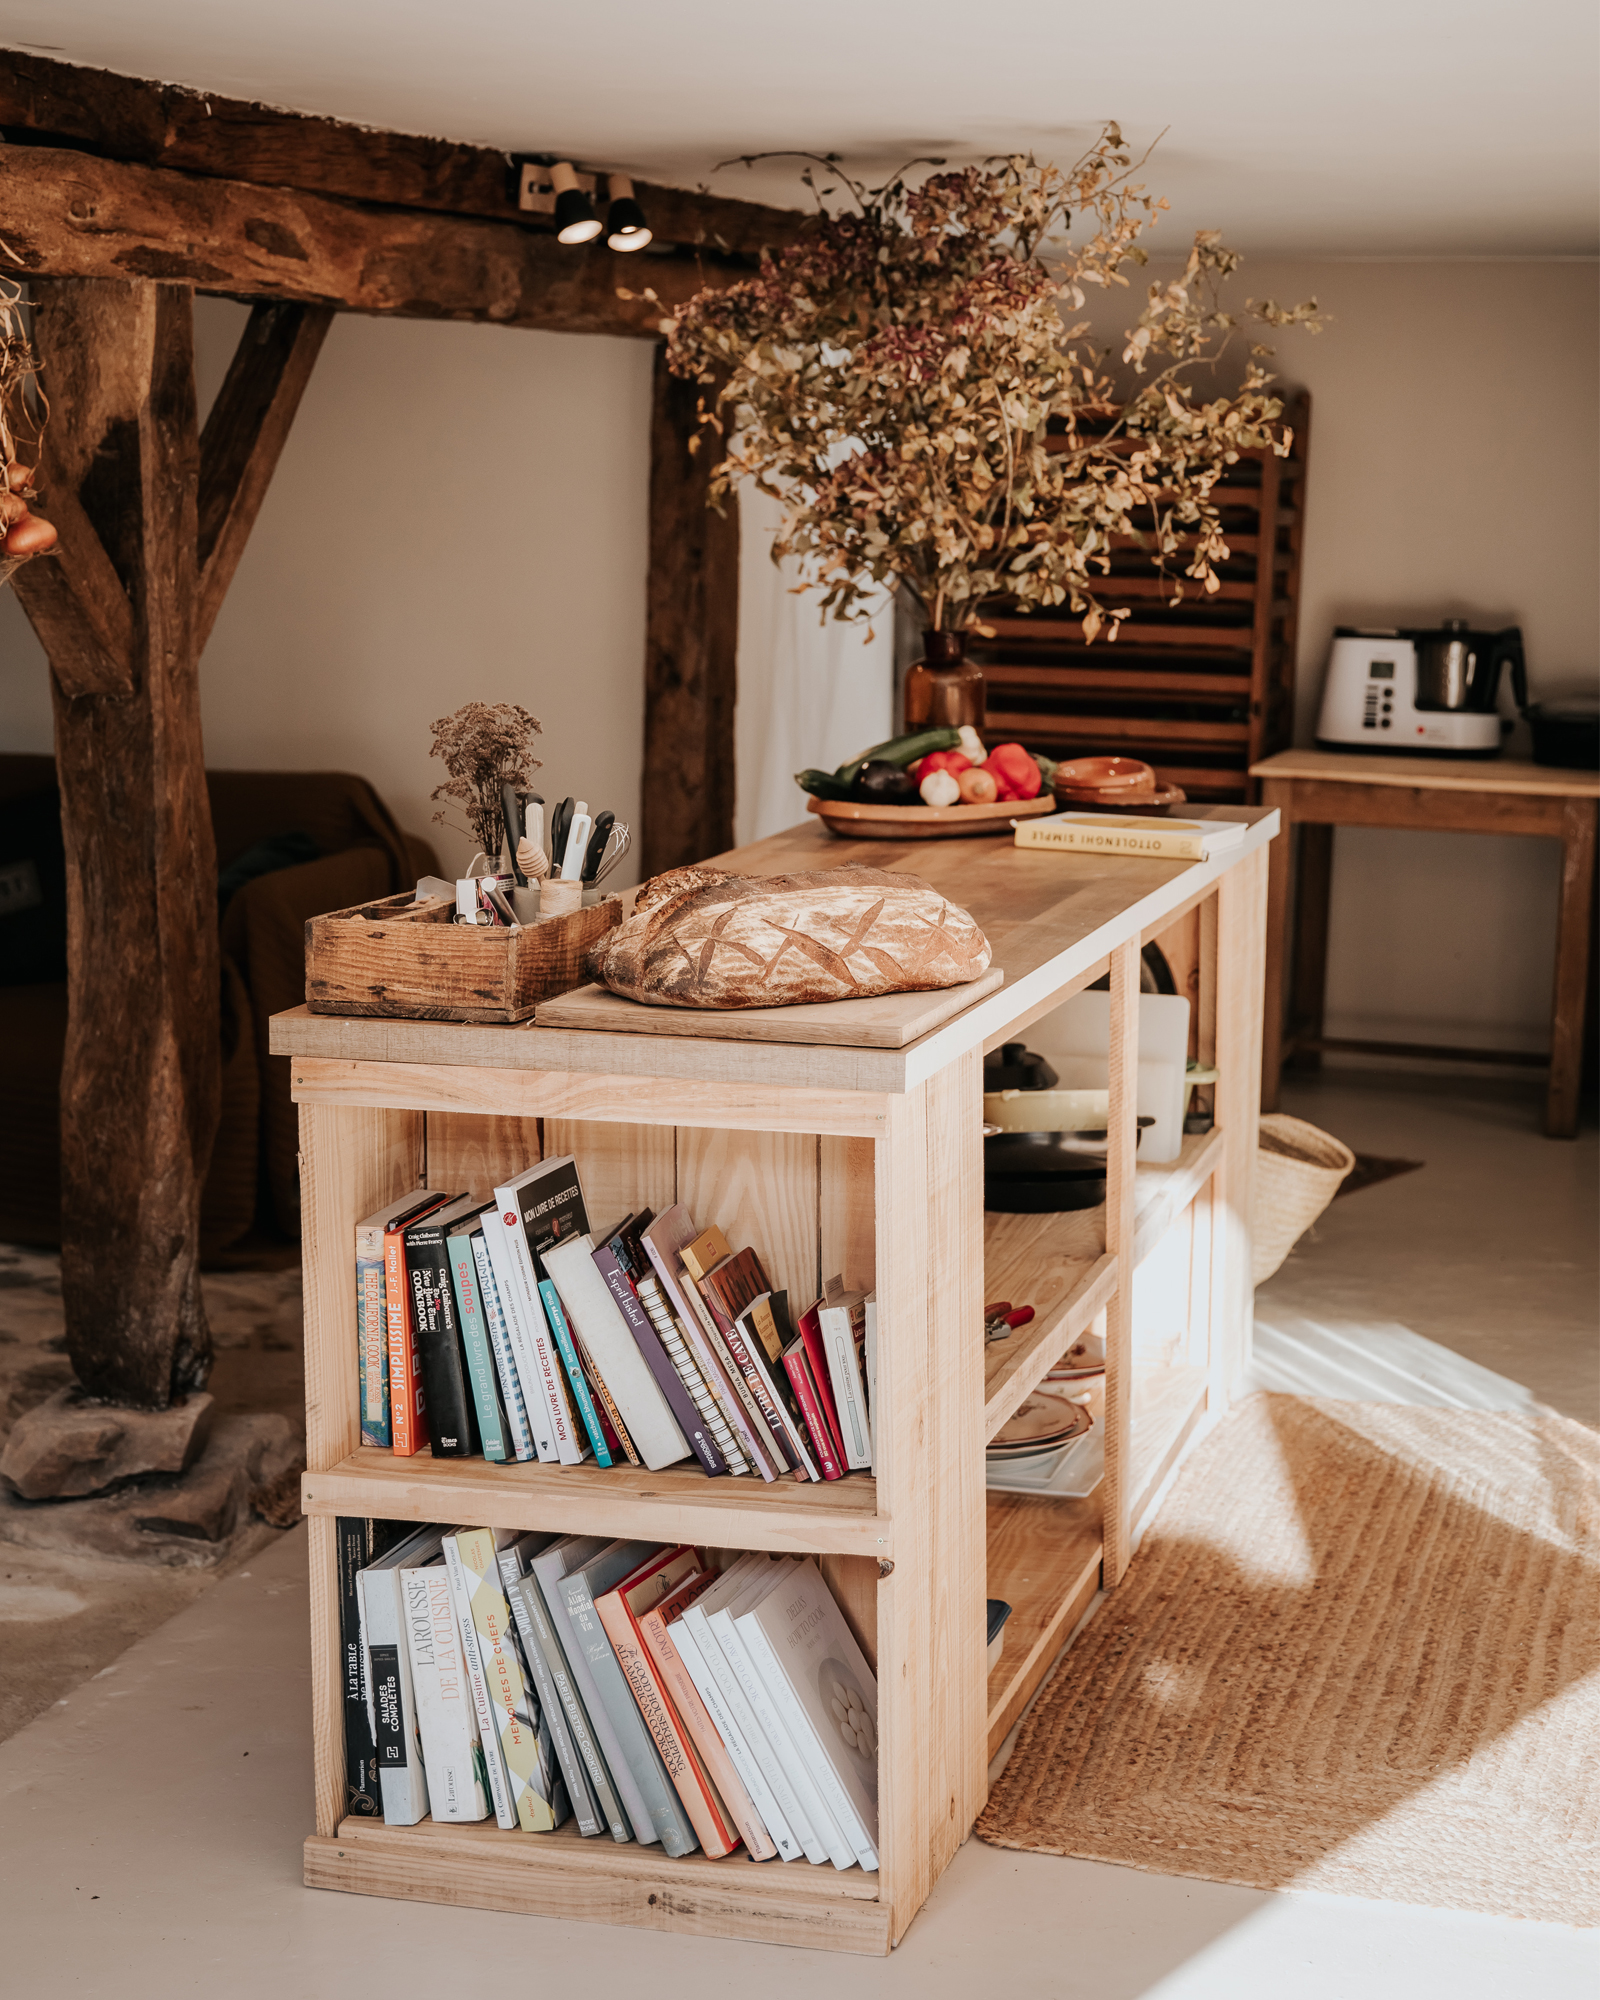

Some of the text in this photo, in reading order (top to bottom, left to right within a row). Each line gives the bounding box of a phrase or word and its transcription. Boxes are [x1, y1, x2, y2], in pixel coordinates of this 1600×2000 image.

[1031, 829, 1162, 850] OTTOLENGHI SIMPLE
[524, 1209, 536, 1223] MON
[536, 1203, 549, 1217] LIVRE
[547, 1199, 556, 1210] DE
[555, 1185, 579, 1206] RECETTES
[388, 1245, 396, 1272] Mallet
[389, 1276, 397, 1293] J.-F.
[412, 1270, 431, 1331] COOKBOOK
[421, 1270, 436, 1330] New York Times
[438, 1267, 453, 1329] Craig Claiborne's
[504, 1279, 512, 1302] CHAMPS
[607, 1268, 643, 1326] Esprit bistrot
[365, 1272, 379, 1368] THE CALIFORNIA COOK
[475, 1251, 511, 1401] SUMMER SUSAN BRANCH
[551, 1305, 561, 1325] currys
[388, 1302, 404, 1389] SIMPLISSIME
[457, 1261, 492, 1418] Le grand livre des soupes
[557, 1326, 570, 1353] meilleurs
[705, 1357, 727, 1394] PAIN MAISON
[724, 1355, 735, 1374] MESA
[725, 1328, 781, 1430] LIVRE DE CAVE
[535, 1337, 566, 1440] MON LIVRE DE RECETTES
[734, 1376, 748, 1398] BUENA
[746, 1400, 753, 1409] LA
[697, 1438, 716, 1468] recettes
[448, 1546, 456, 1565] Gessel
[470, 1547, 478, 1570] NICOLAS
[474, 1540, 484, 1568] CHATENIER
[567, 1600, 593, 1616] Mondial
[568, 1594, 586, 1606] Atlas
[579, 1612, 588, 1622] du
[407, 1580, 434, 1665] LAROUSSE
[428, 1577, 459, 1700] DE LA CUISINE
[580, 1621, 594, 1632] Vin
[787, 1605, 825, 1649] HOW TO COOK
[462, 1618, 490, 1731] La Cuisine anti-stress
[486, 1614, 521, 1744] MEMOIRES DE CHEFS
[696, 1627, 734, 1695] HOW TO COOK
[721, 1633, 759, 1702] HOW TO COOK
[347, 1692, 358, 1700] À
[379, 1684, 389, 1723] SALADES
[385, 1676, 399, 1731] COMPLÈTES
[528, 1636, 538, 1658] Friedrich
[555, 1726, 565, 1747] Michael
[687, 1698, 698, 1716] VOTRE
[704, 1687, 717, 1708] CHAMPS
[555, 1673, 604, 1783] PARIS BISTRO COOKING
[615, 1643, 655, 1717] ALL-AMERICAN
[649, 1718, 679, 1778] COOKBOOK
[633, 1660, 651, 1692] GOOD
[645, 1692, 685, 1770] HOUSEKEEPING
[715, 1708, 723, 1720] DES
[721, 1720, 737, 1747] RÉGALADE
[447, 1768, 455, 1801] Larousse
[761, 1756, 795, 1813] DELIA SMITH
[818, 1764, 853, 1823] DELIA SMITH
[580, 1824, 596, 1832] Books
[744, 1821, 762, 1854] Flammarion
